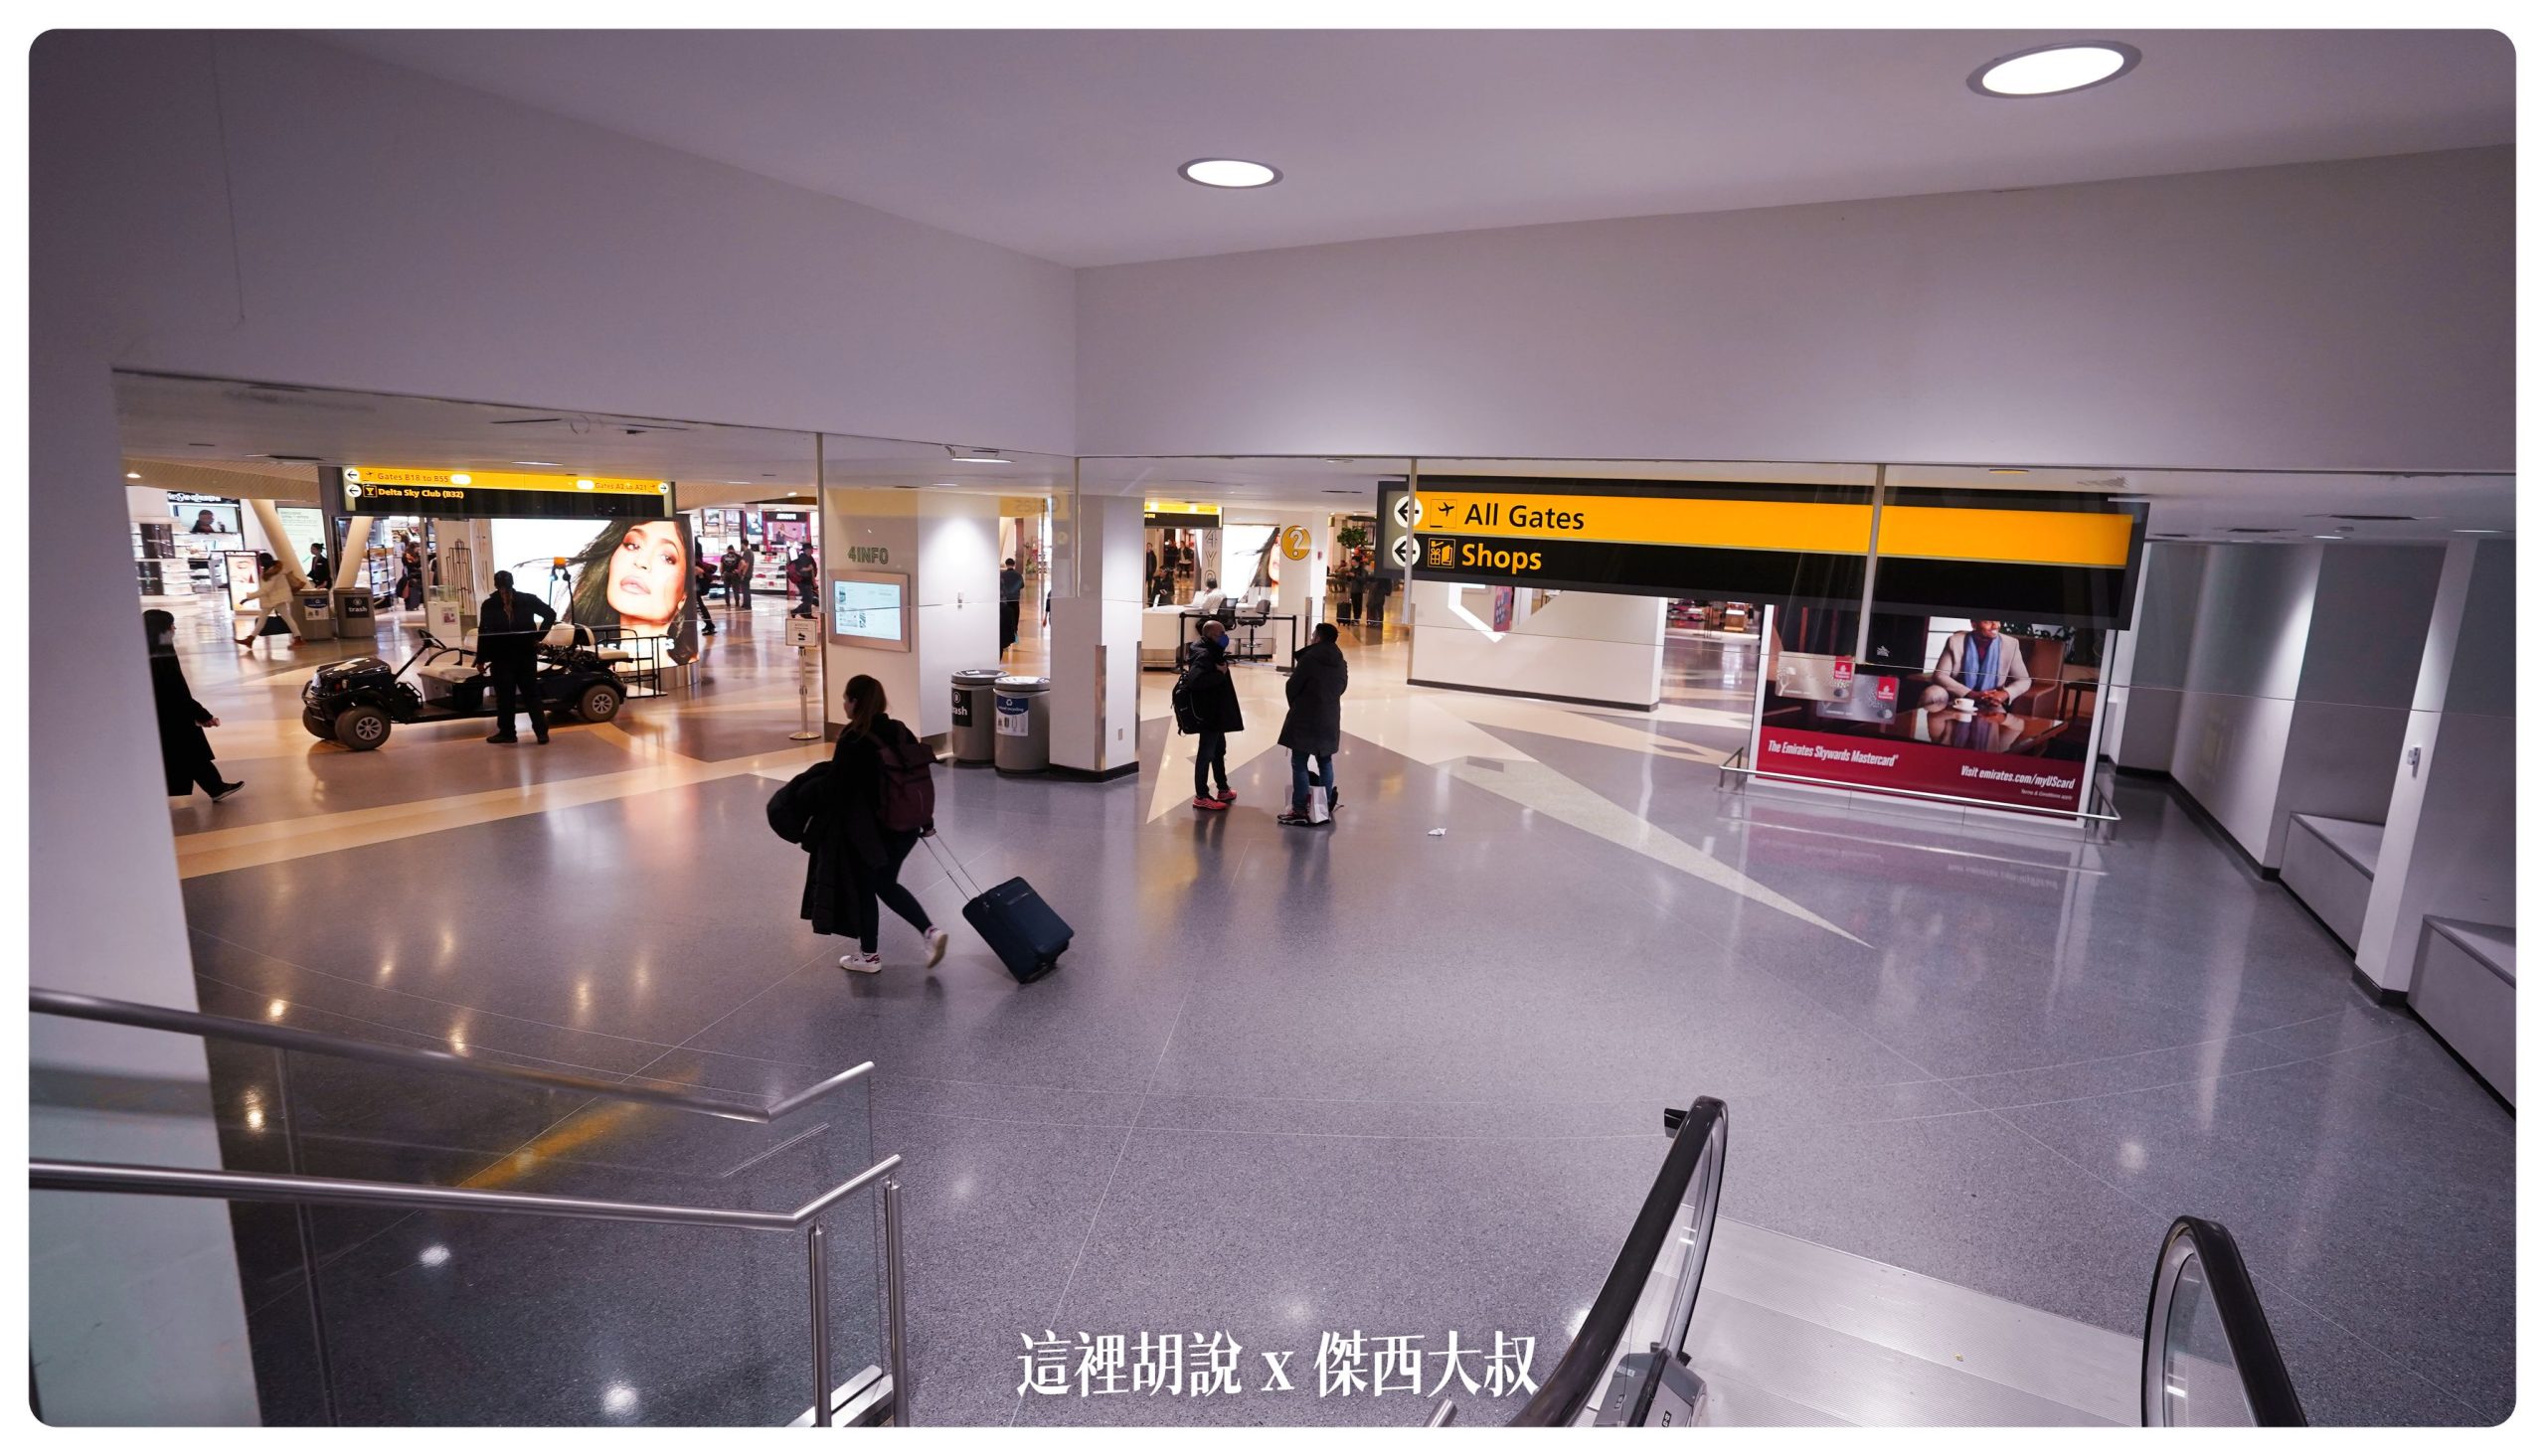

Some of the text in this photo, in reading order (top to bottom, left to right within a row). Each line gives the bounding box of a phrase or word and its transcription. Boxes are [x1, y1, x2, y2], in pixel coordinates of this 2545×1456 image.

[378, 472, 403, 481] Gates
[378, 488, 464, 499] Delta Sky Club (B32)
[1463, 502, 1585, 530] All Gates
[847, 546, 890, 565] 4INFO
[1461, 543, 1542, 574] Shops
[1768, 739, 1782, 753] The
[1782, 741, 1814, 757] Emirates
[1814, 745, 1851, 761] Skywards
[1960, 764, 2076, 789] Visit emirates.com/myUScard
